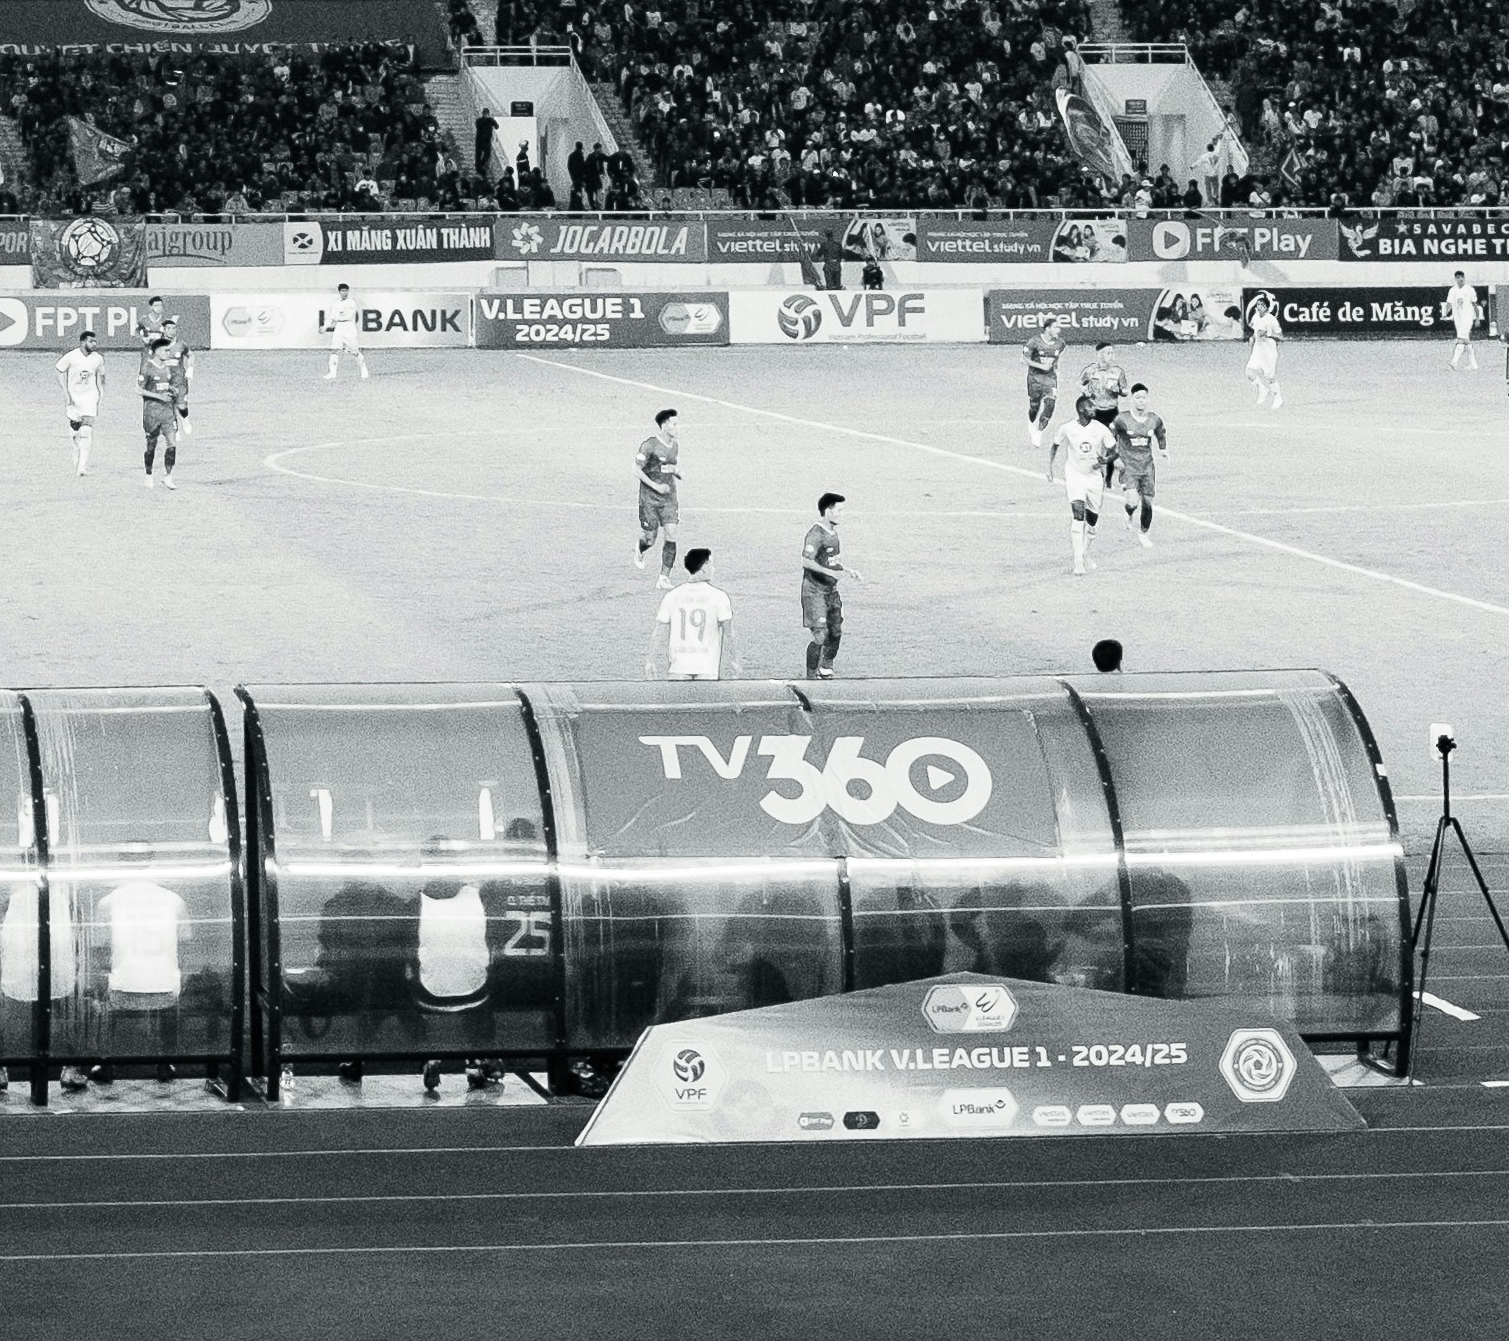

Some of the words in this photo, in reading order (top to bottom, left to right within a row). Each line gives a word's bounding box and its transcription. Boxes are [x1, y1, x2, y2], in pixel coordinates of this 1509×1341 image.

[327, 230, 342, 252] XI
[346, 225, 392, 251] MĂNG
[395, 224, 438, 250] XUÂN
[440, 223, 491, 249] THÀNH
[551, 224, 688, 255] JOGARBOLA
[1254, 226, 1313, 258] Play
[1378, 238, 1417, 256] BIA
[1423, 238, 1488, 255] NGHE
[35, 306, 100, 337] FPT
[318, 308, 463, 333] LBANK
[480, 298, 622, 320] V.LEAGUE
[628, 297, 645, 319] 1
[829, 293, 926, 328] VPF
[1284, 301, 1335, 322] Café
[1338, 302, 1364, 322] de
[1370, 299, 1434, 326] Măng
[515, 322, 611, 344] 2024/25
[679, 607, 706, 642] 19
[638, 733, 993, 825] TV360
[504, 910, 553, 956] 25
[766, 1048, 884, 1073] LPBANK
[891, 1046, 1030, 1070] V.LEAGUE
[1035, 1046, 1051, 1067] 1
[1071, 1043, 1188, 1068] 2024/25
[675, 1088, 707, 1100] VPF
[953, 1101, 995, 1115] LPBank
